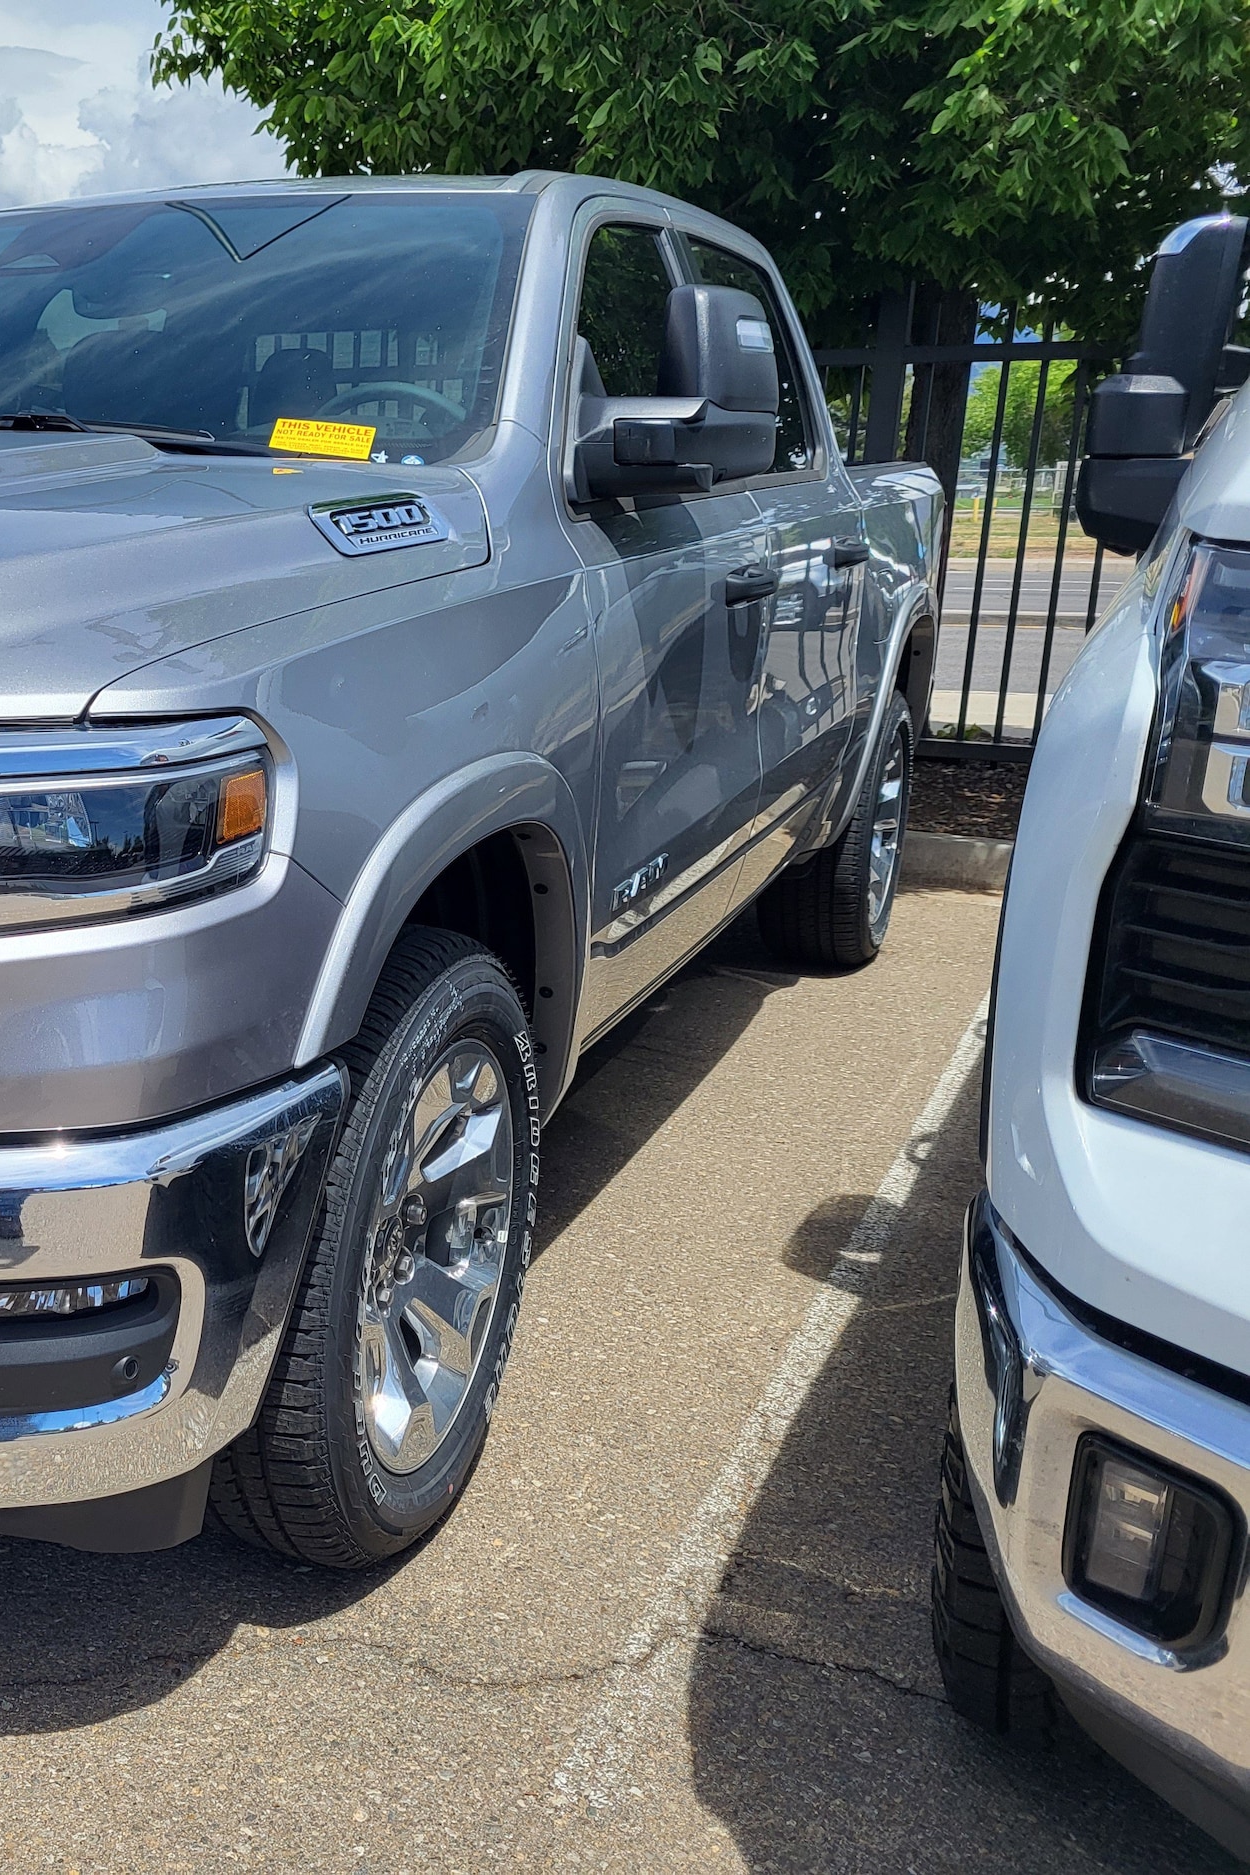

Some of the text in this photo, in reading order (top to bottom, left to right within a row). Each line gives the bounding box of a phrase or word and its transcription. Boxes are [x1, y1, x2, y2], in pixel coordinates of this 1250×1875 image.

[280, 420, 374, 437] THIS VEHICLE
[296, 430, 328, 438] READY
[329, 433, 347, 441] FOR
[348, 435, 371, 443] SALE
[333, 504, 425, 534] 1500
[360, 527, 434, 545] HURRICANE
[609, 852, 669, 912] RAM
